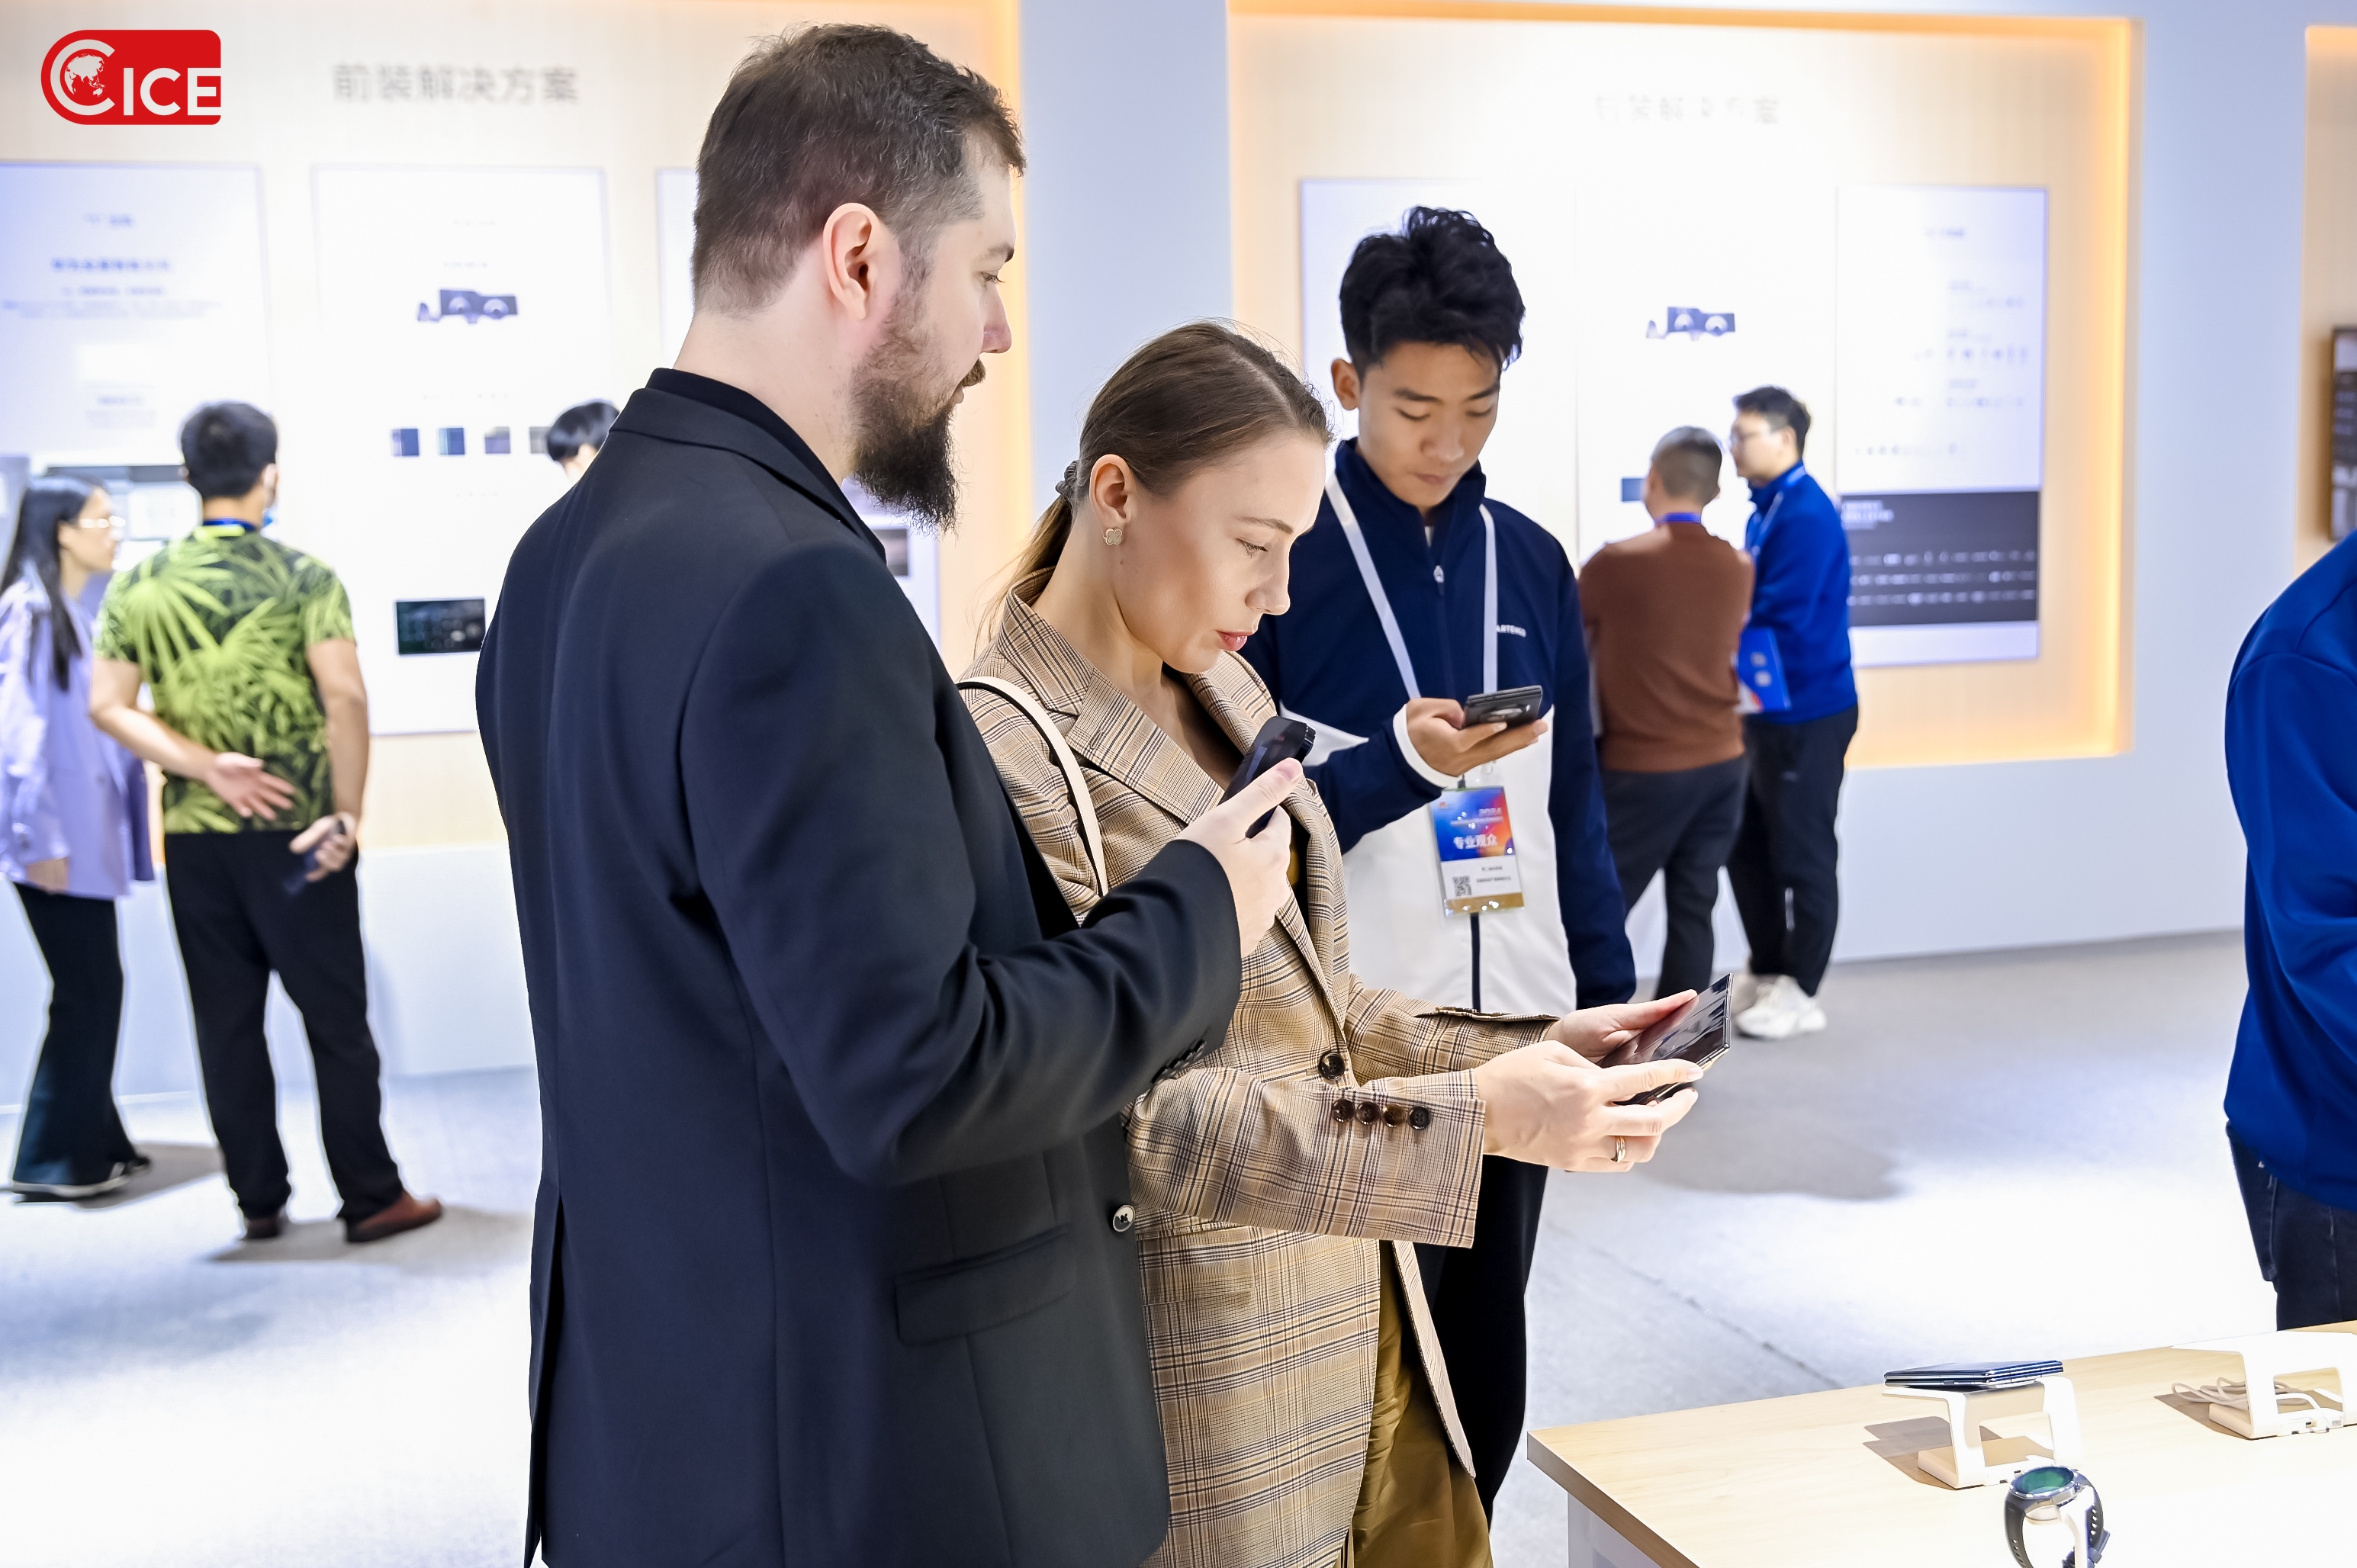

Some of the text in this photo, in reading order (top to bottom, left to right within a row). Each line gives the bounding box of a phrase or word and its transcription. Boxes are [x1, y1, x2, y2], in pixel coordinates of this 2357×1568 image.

[334, 63, 579, 104] 前装解决方案
[1453, 834, 1497, 850] 专业观众
